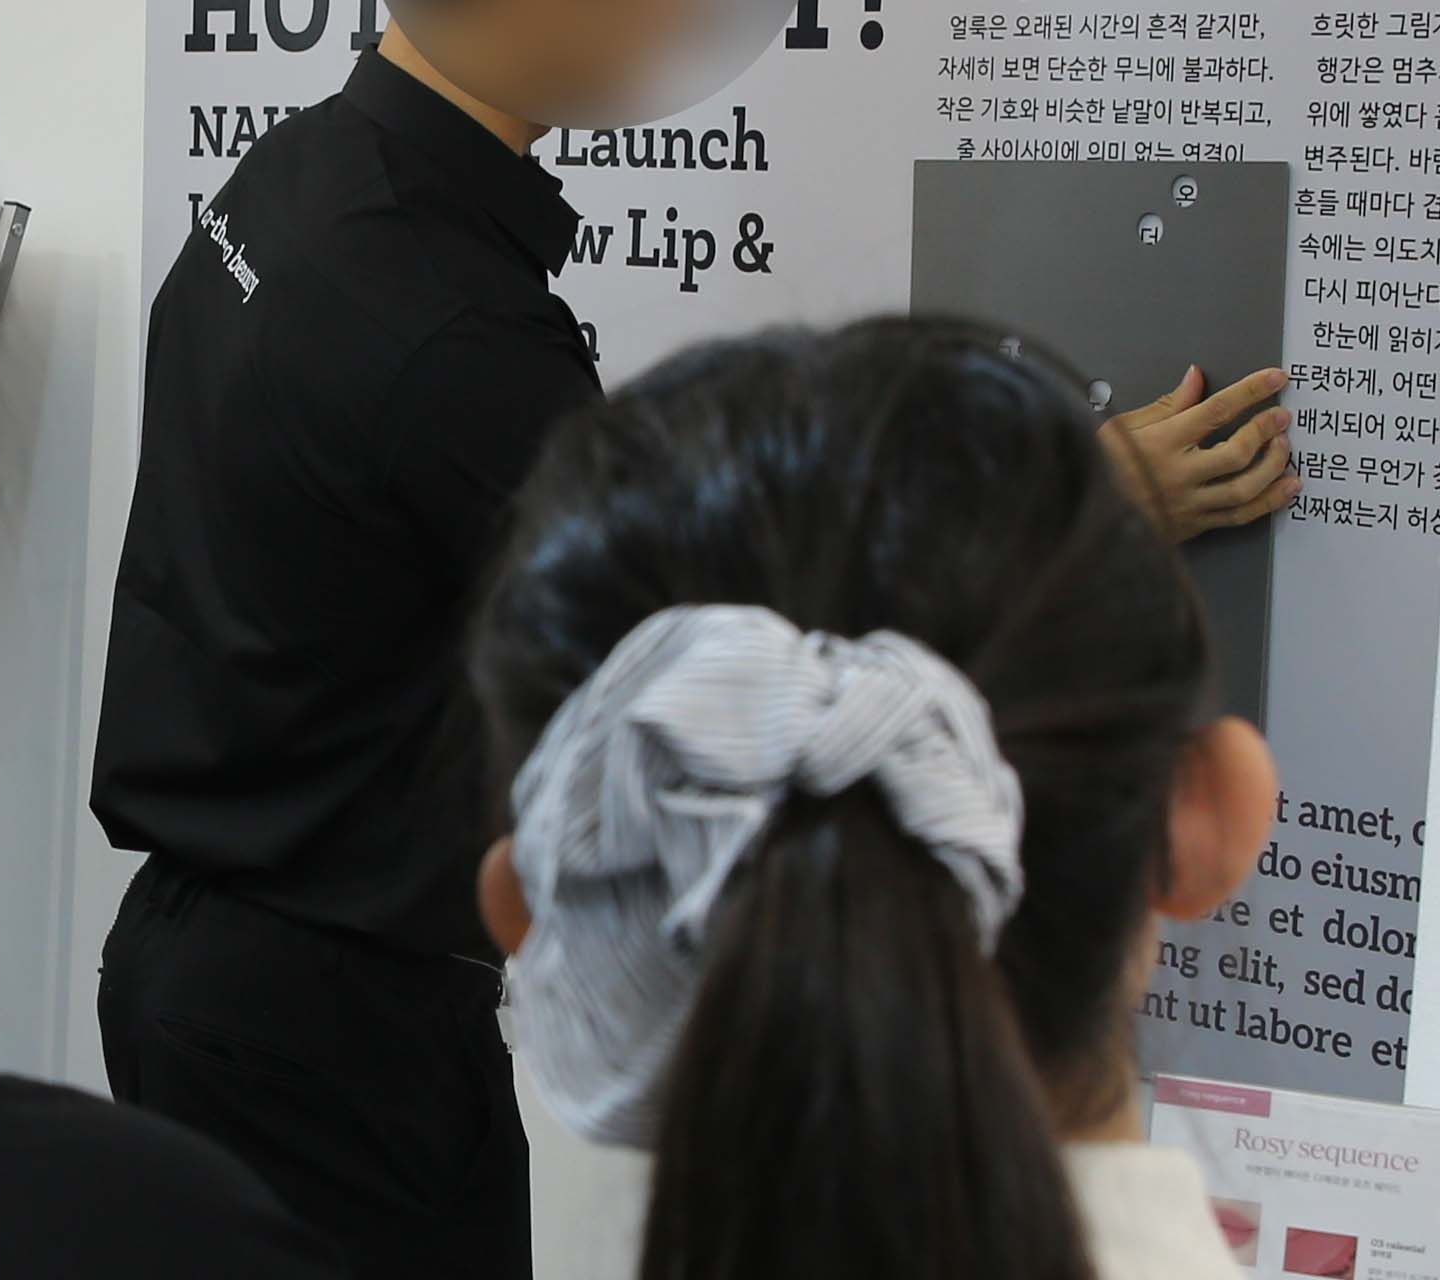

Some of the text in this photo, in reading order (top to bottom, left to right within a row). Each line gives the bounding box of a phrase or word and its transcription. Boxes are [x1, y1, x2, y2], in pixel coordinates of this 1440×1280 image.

[950, 13, 1266, 40] 얼룩은 오래된 시간의 흔적 같지만,
[1311, 12, 1379, 39] 흐릿한
[938, 56, 1274, 83] 자세히 보면 단순한 무늬에 불과하다.
[1317, 56, 1384, 84] 행간은
[936, 97, 1272, 126] 작은 기호와 비슷한 낱말이 반복되고,
[1307, 101, 1350, 128] 위에
[1359, 102, 1427, 129] 쌓였다
[555, 106, 769, 172] Launch
[957, 138, 976, 160] 줄
[981, 138, 1079, 161] 사이사이에
[1087, 140, 1126, 161] 의미
[1305, 145, 1399, 173] 변주된다.
[1294, 188, 1339, 216] 흔들
[1347, 190, 1415, 219] 때마다
[626, 206, 716, 293] Lip
[732, 213, 775, 274] &
[1299, 233, 1366, 261] 속에는
[1374, 236, 1440, 266] 의도치
[1304, 277, 1348, 305] 다시
[1313, 321, 1379, 351] 한눈에
[1288, 364, 1383, 396] 뚜렷하게,
[1393, 371, 1437, 400] 어떤
[1297, 408, 1384, 440] 배치되어
[1288, 451, 1349, 482] 사람은
[1357, 457, 1425, 489] 무언가
[1288, 495, 1398, 531] 진짜였는지
[1298, 801, 1401, 848] amet,
[1257, 841, 1302, 881] do
[1269, 904, 1304, 938] et
[1218, 946, 1285, 994] elit,
[1303, 968, 1365, 1006] sed
[1188, 998, 1227, 1033] ut
[1235, 1001, 1353, 1059] labore
[1371, 1036, 1407, 1071] et
[1234, 1127, 1420, 1173] Rosy sequence
